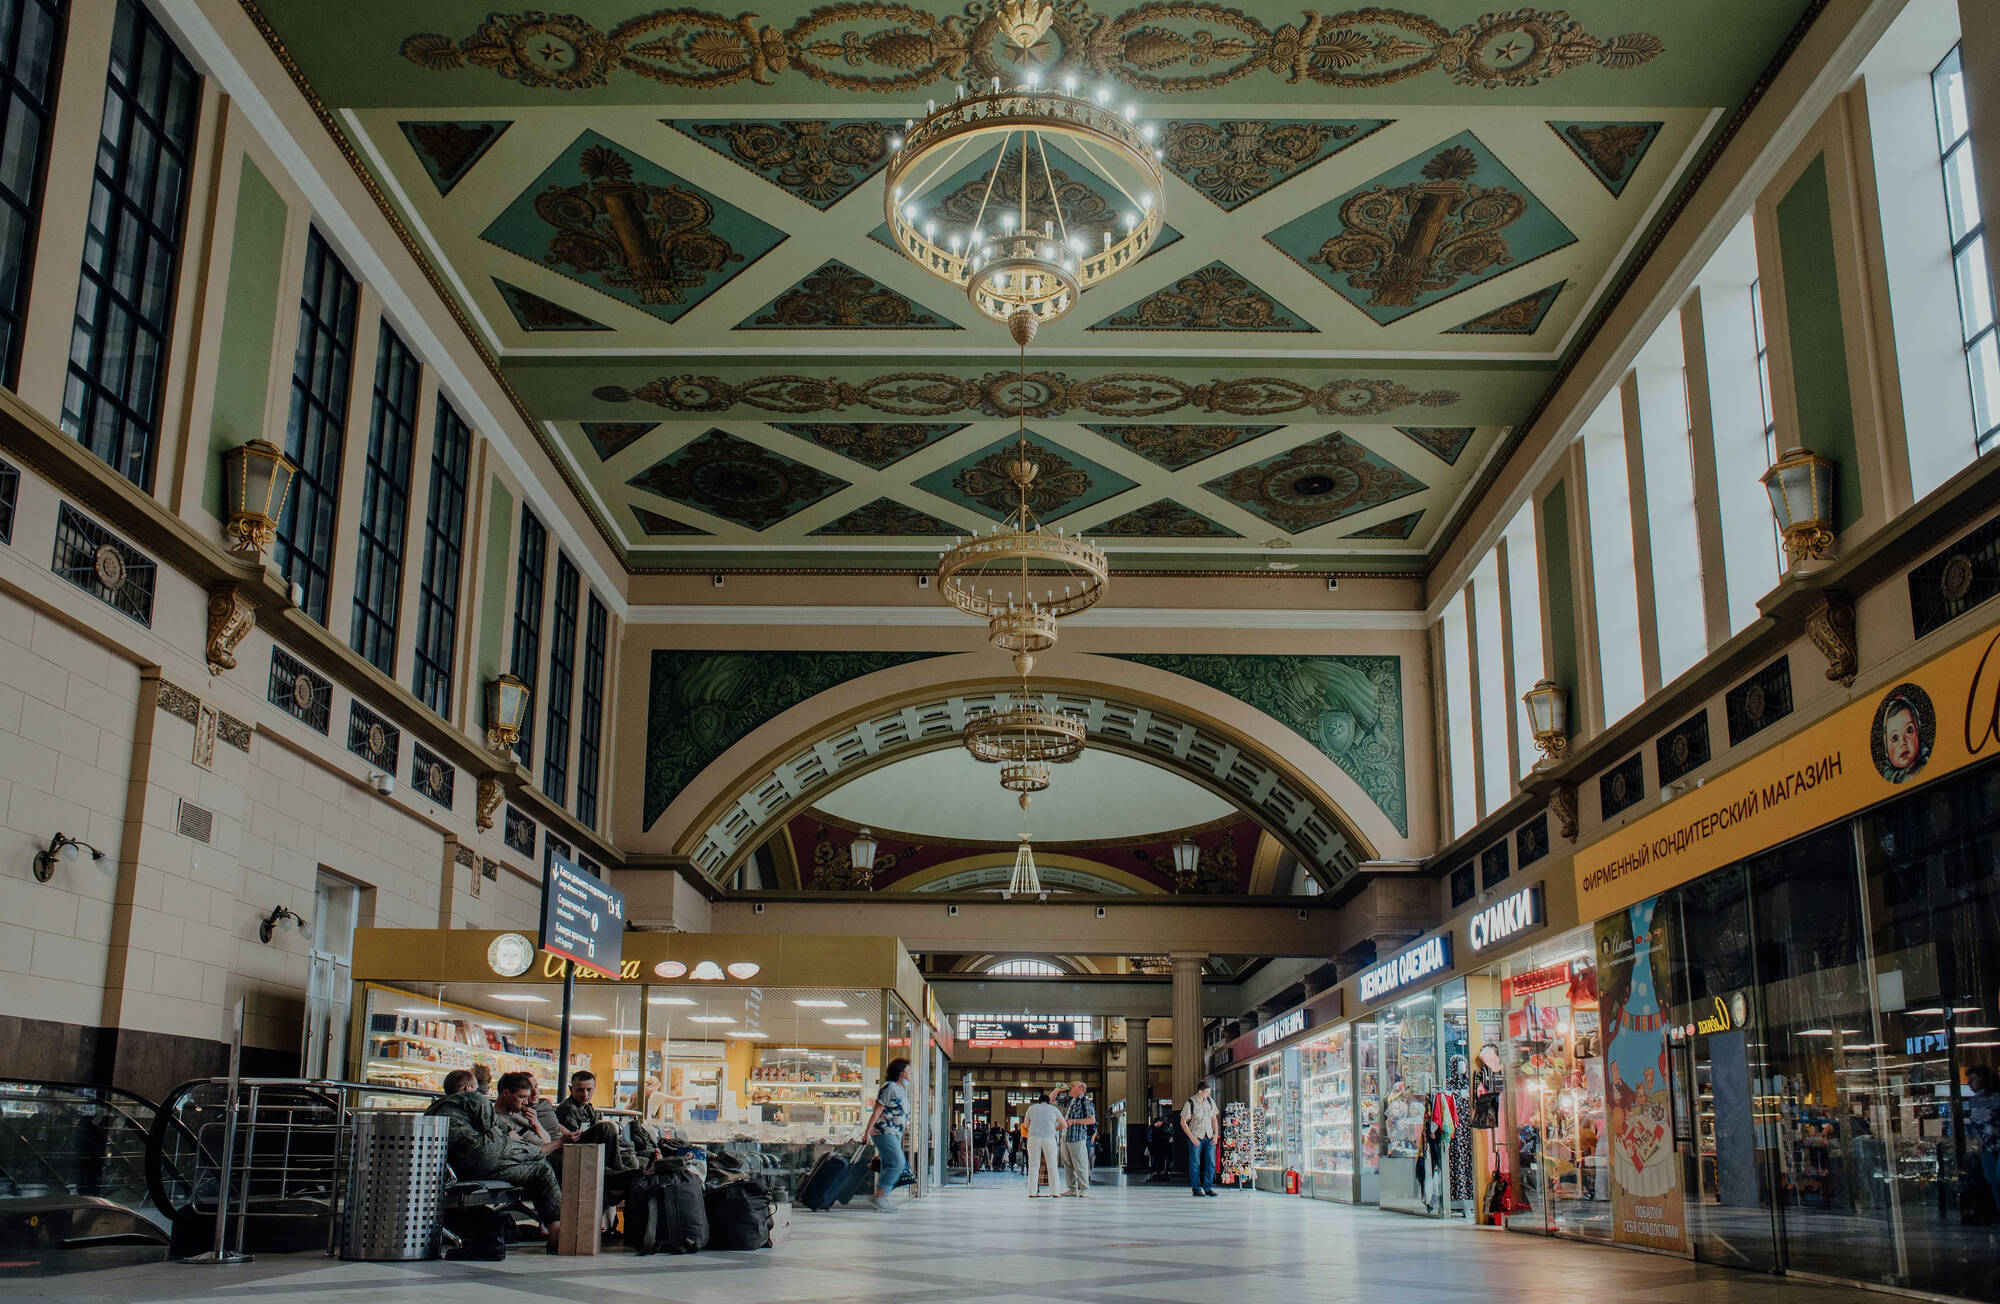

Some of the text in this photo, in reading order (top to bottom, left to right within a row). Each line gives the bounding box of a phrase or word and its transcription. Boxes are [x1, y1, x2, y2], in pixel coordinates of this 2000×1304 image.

[1582, 751, 1843, 893] ФИРМЕННЫЙ КОНДИТЕРСКИЙ МАГАЗИН
[1470, 888, 1533, 951] СУМКИ
[1360, 937, 1444, 1002] ЖЕНСКАЯ ОДЕЖДА
[1477, 1010, 1502, 1021] ВЫХО
[1623, 1220, 1679, 1239] СЕБЯ СЛАДОСТЯМИ
